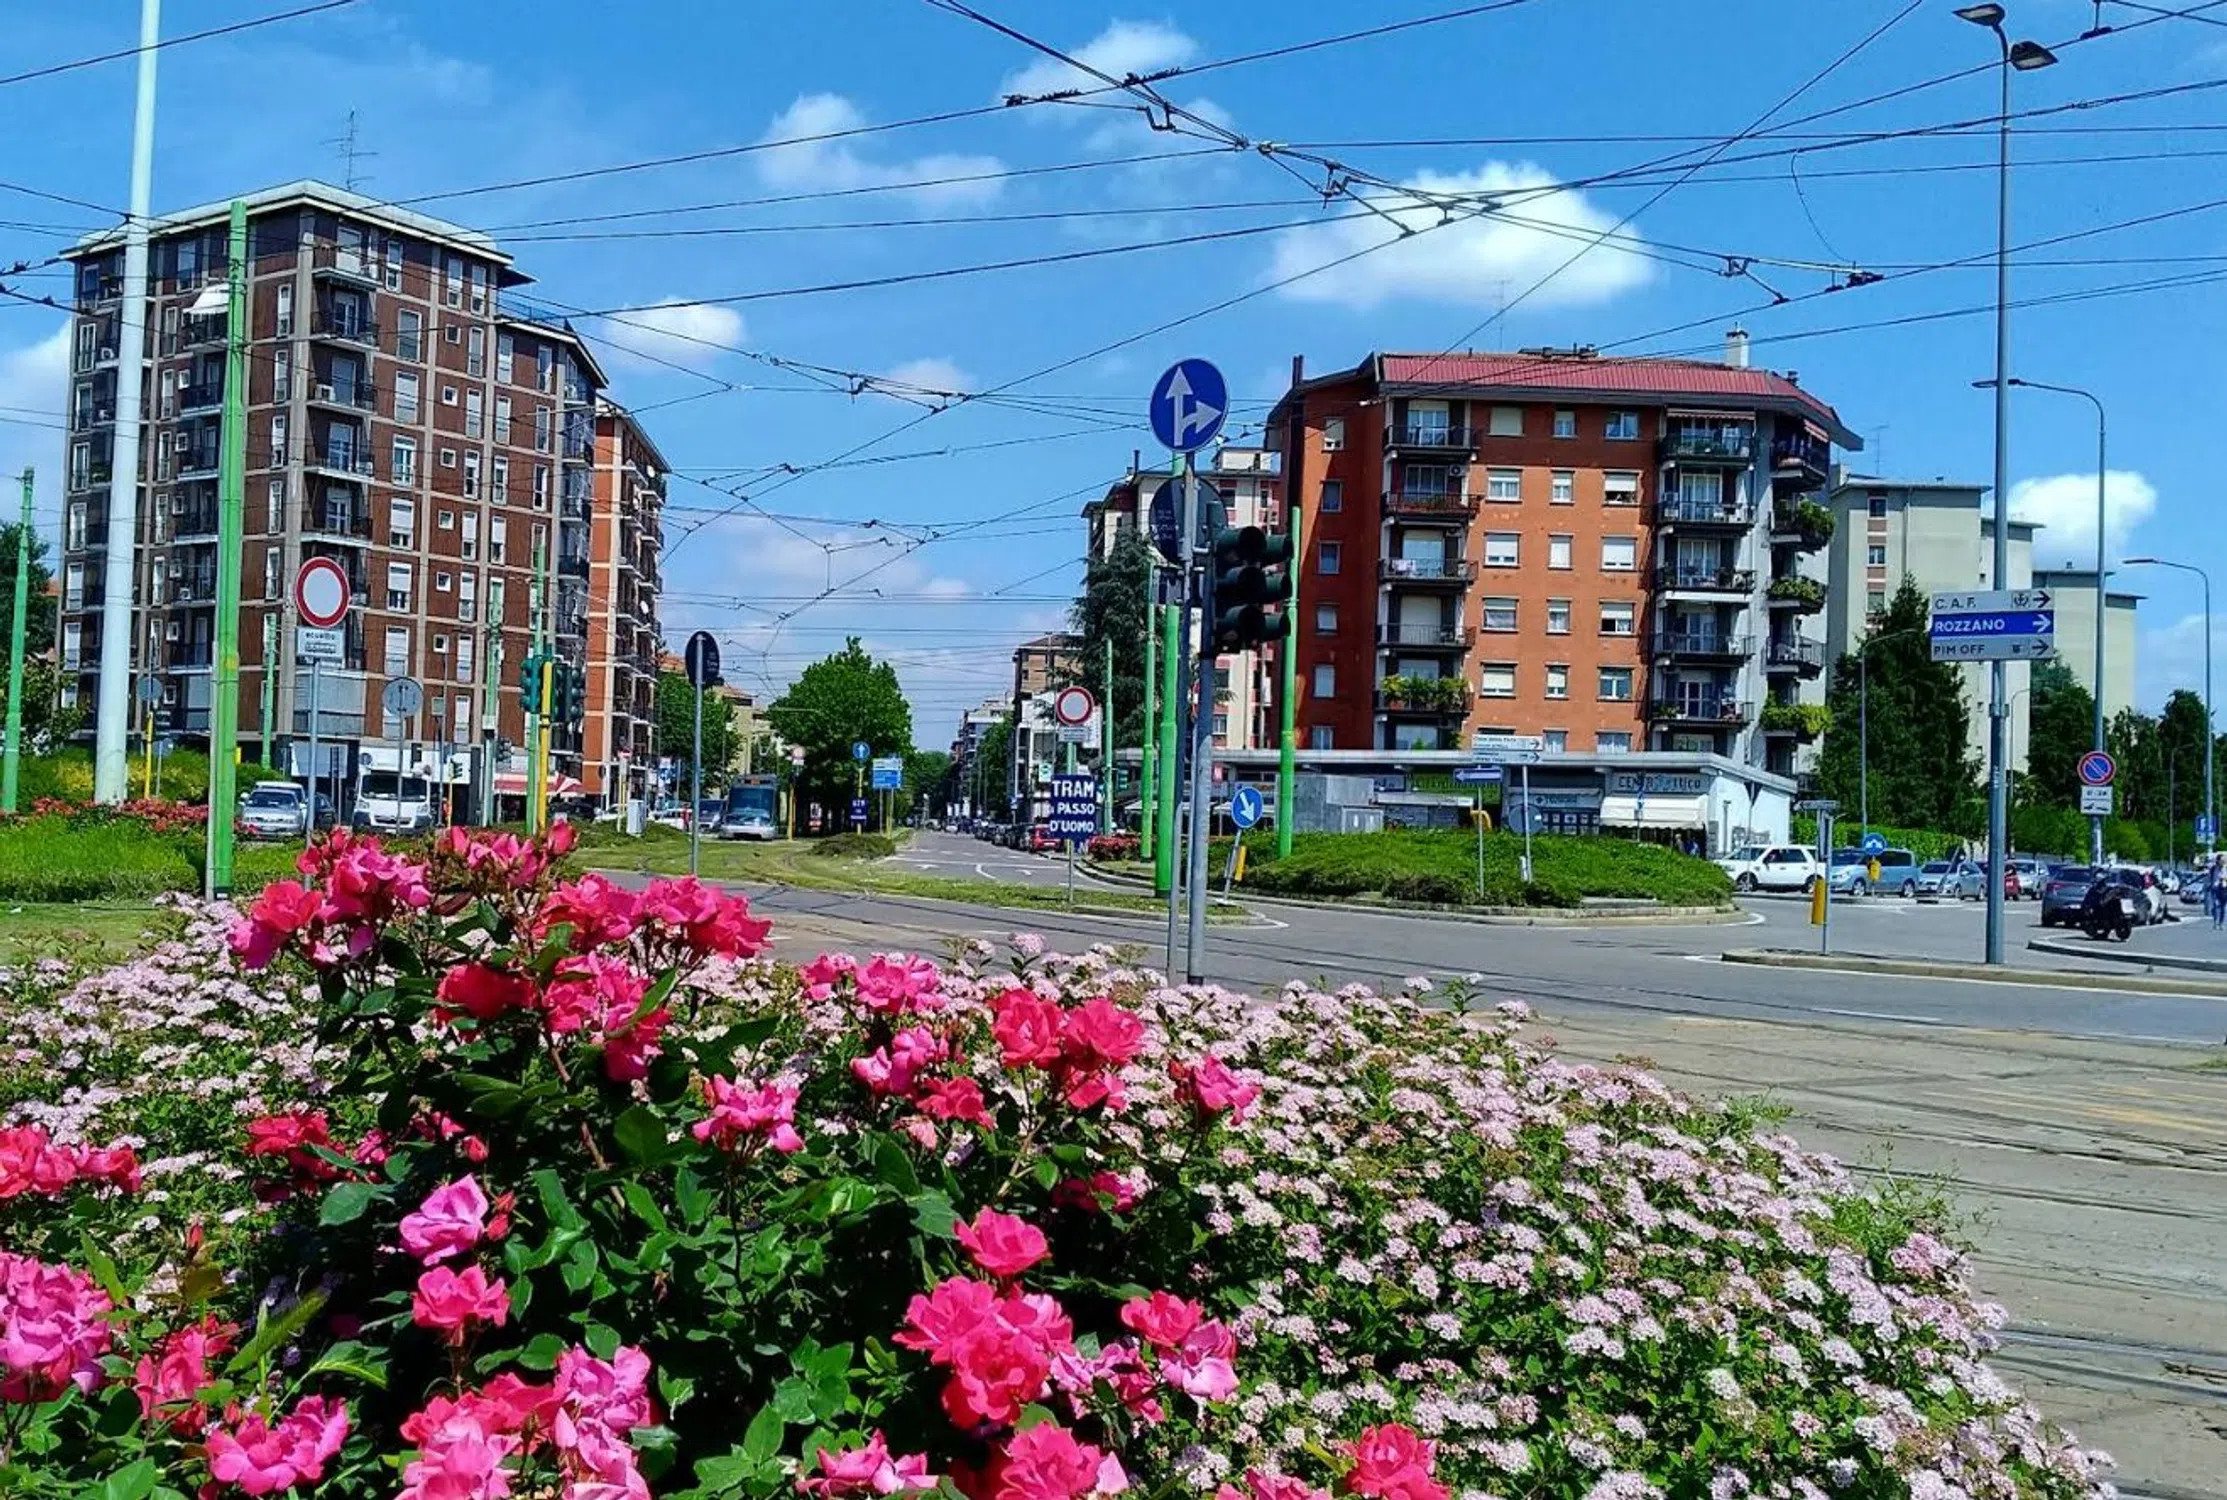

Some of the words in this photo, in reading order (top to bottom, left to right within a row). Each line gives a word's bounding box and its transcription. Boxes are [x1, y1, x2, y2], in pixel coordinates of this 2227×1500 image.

[1934, 619, 2005, 633] ROZZANO
[1934, 645, 1957, 655] PIM
[1960, 644, 1985, 655] OFF
[1052, 780, 1095, 798] TRAM
[1057, 801, 1096, 815] PASSO
[1050, 820, 1095, 833] D'UOMO
